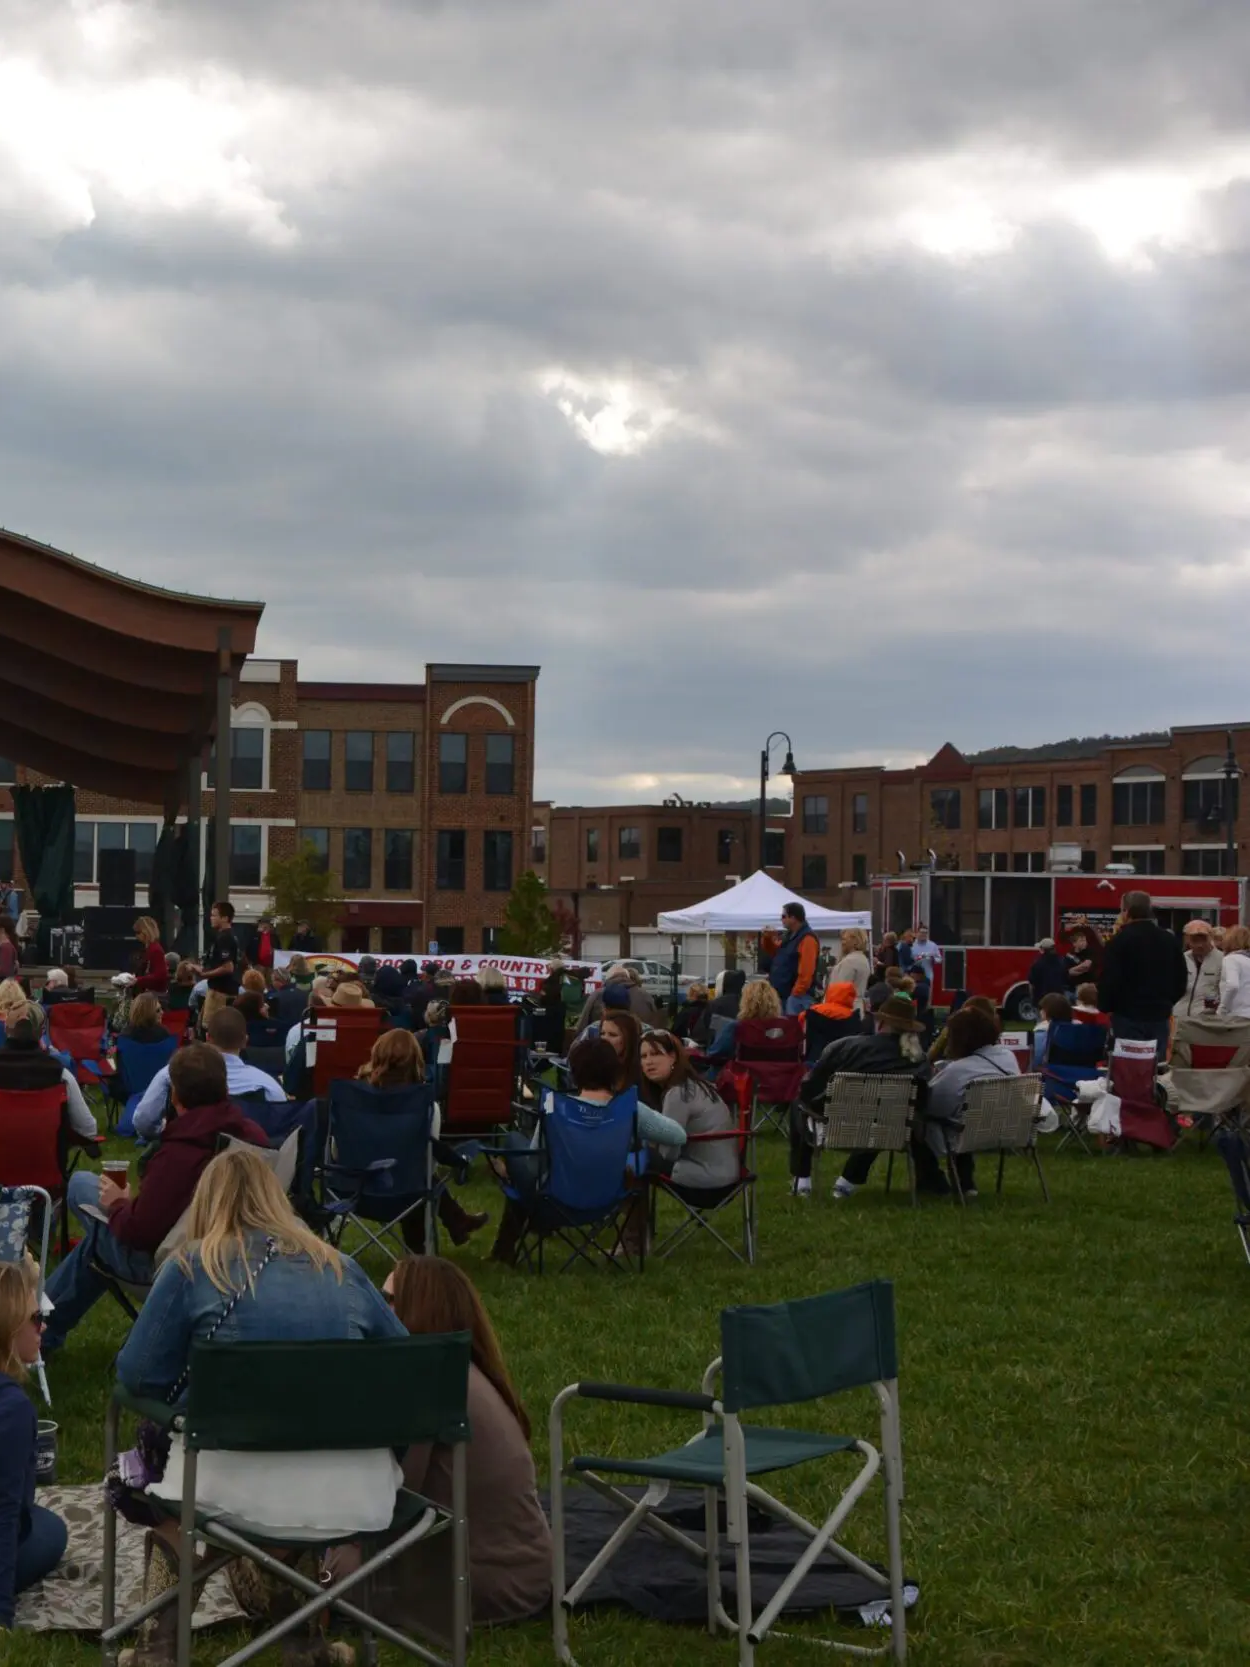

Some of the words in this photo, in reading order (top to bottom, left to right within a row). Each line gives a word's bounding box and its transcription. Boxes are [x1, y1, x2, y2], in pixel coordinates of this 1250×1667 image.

[461, 959, 472, 970] &
[478, 959, 553, 976] COUNTRY
[521, 978, 537, 991] 18
